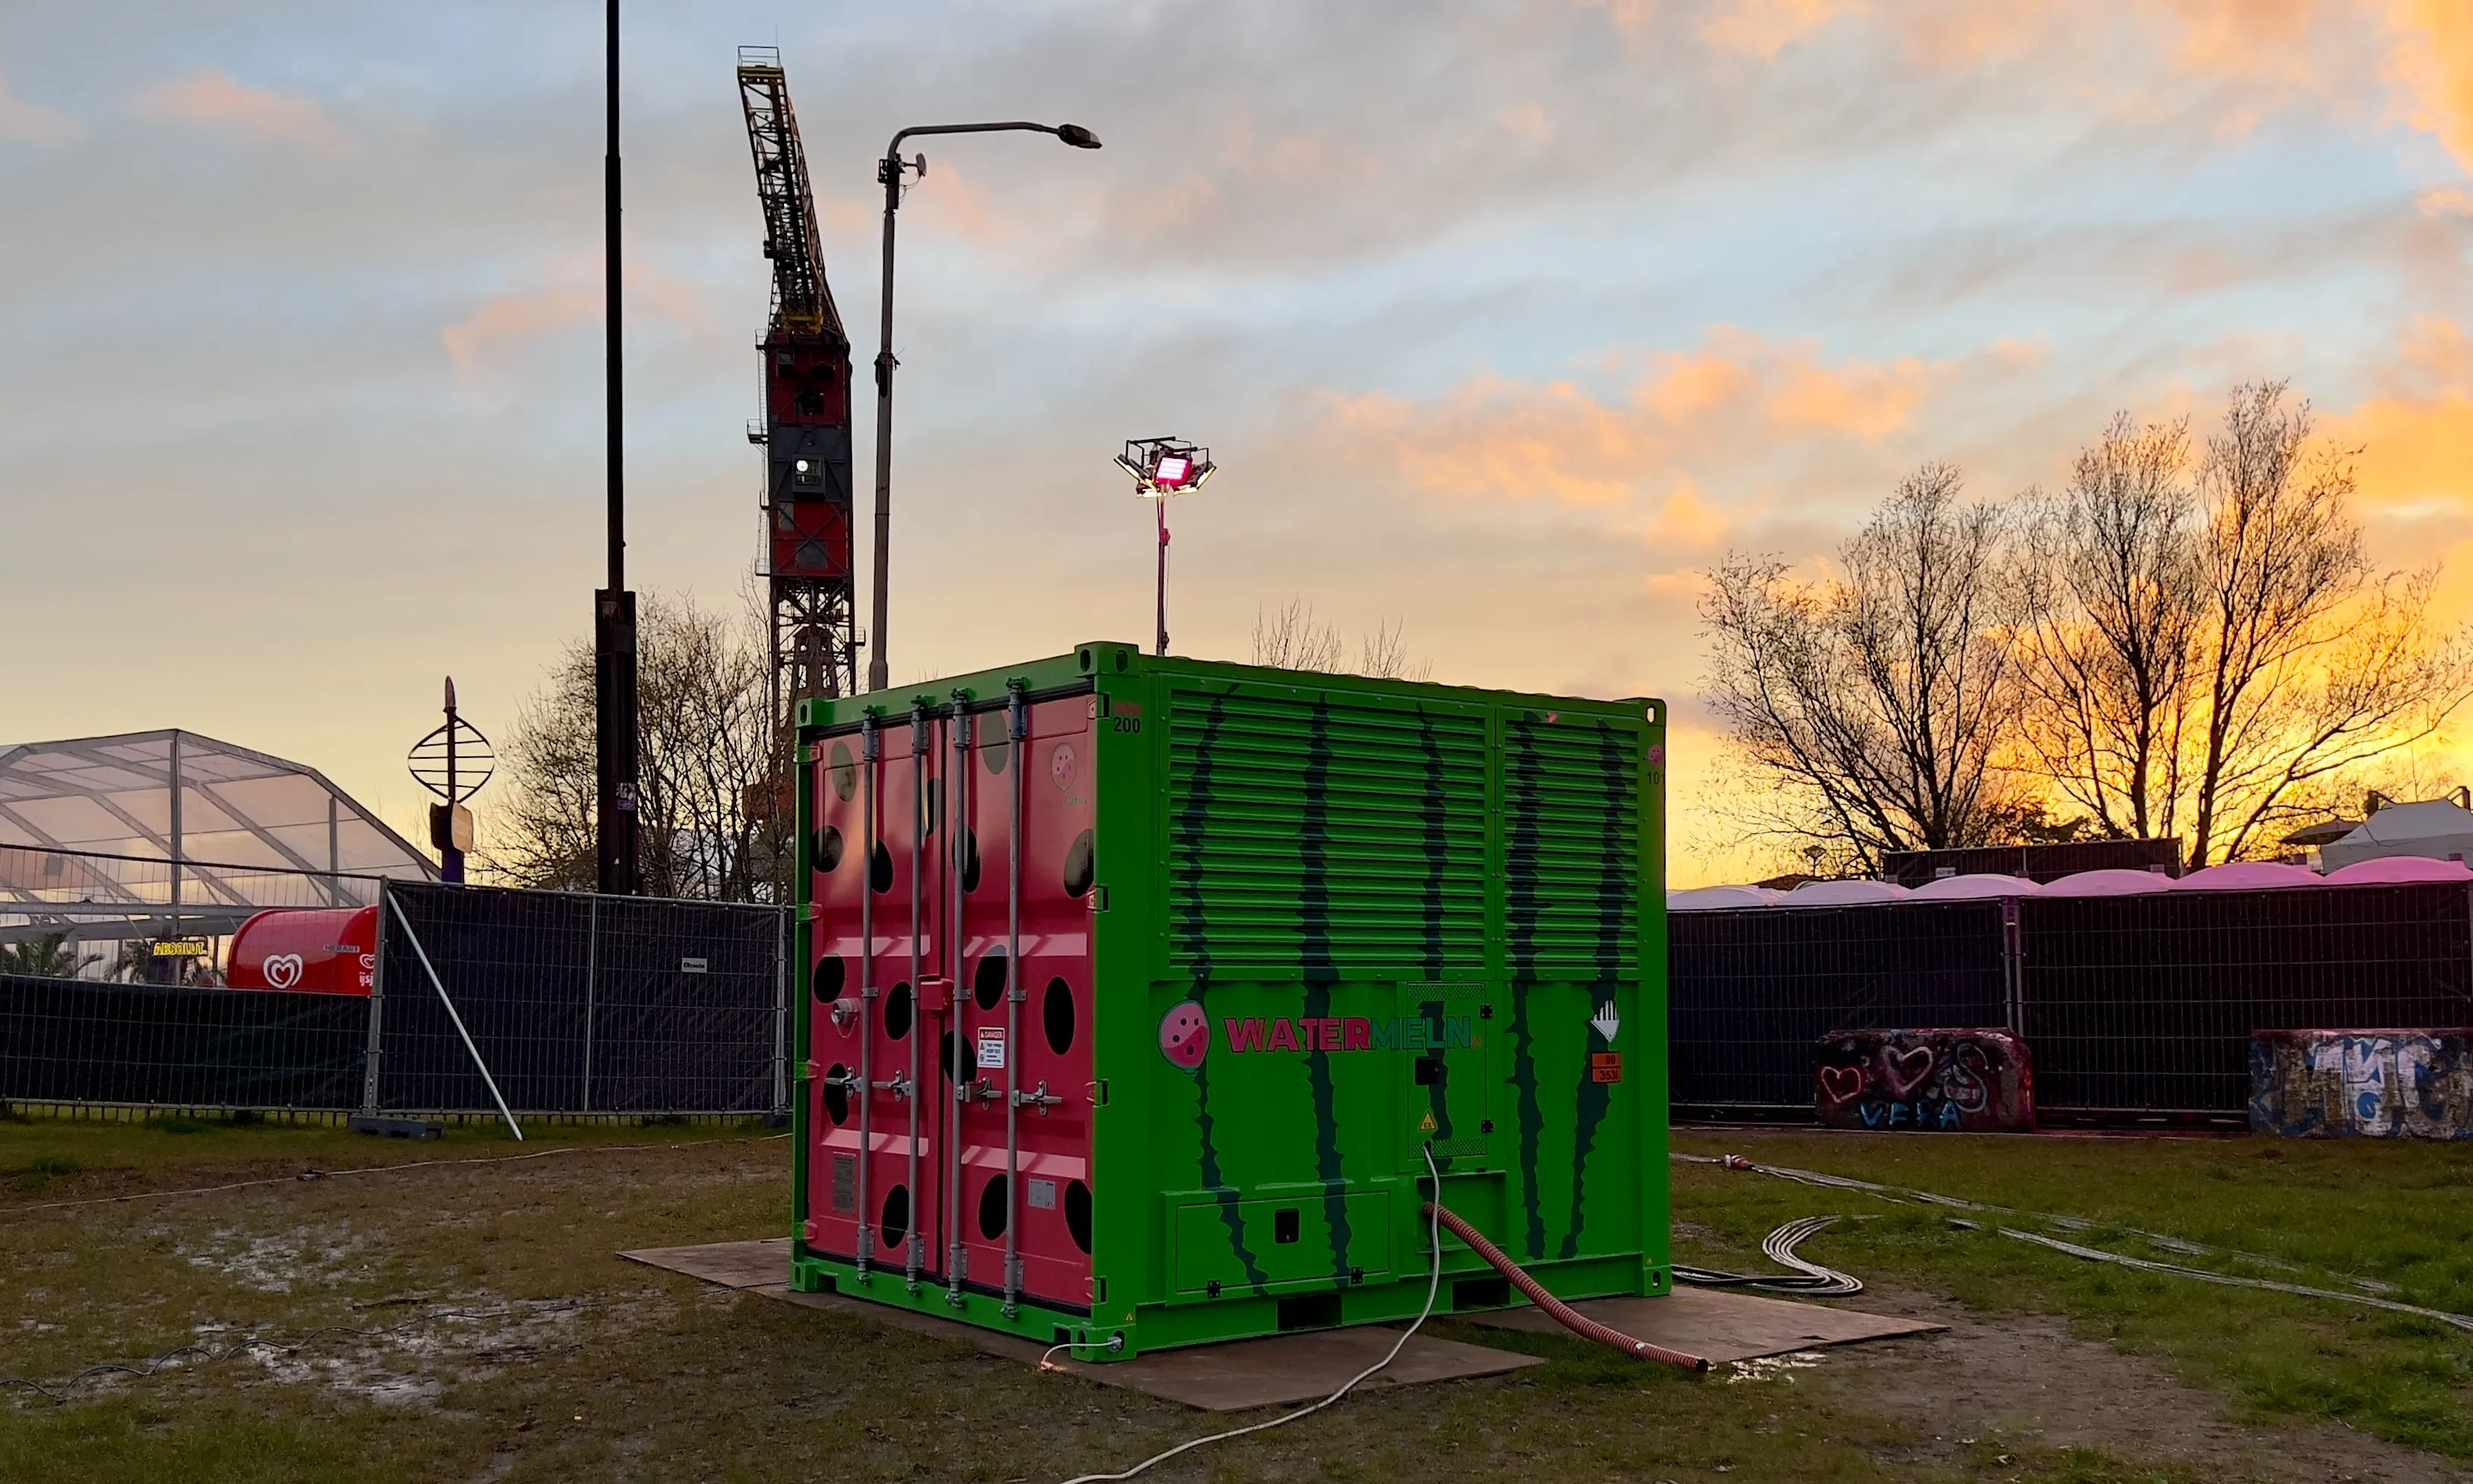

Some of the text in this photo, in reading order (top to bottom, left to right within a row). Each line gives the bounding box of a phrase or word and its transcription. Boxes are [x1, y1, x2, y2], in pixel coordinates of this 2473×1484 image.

[1113, 716, 1141, 734] 200
[1223, 1015, 1472, 1053] WATERMELN
[1605, 1054, 1616, 1065] 90
